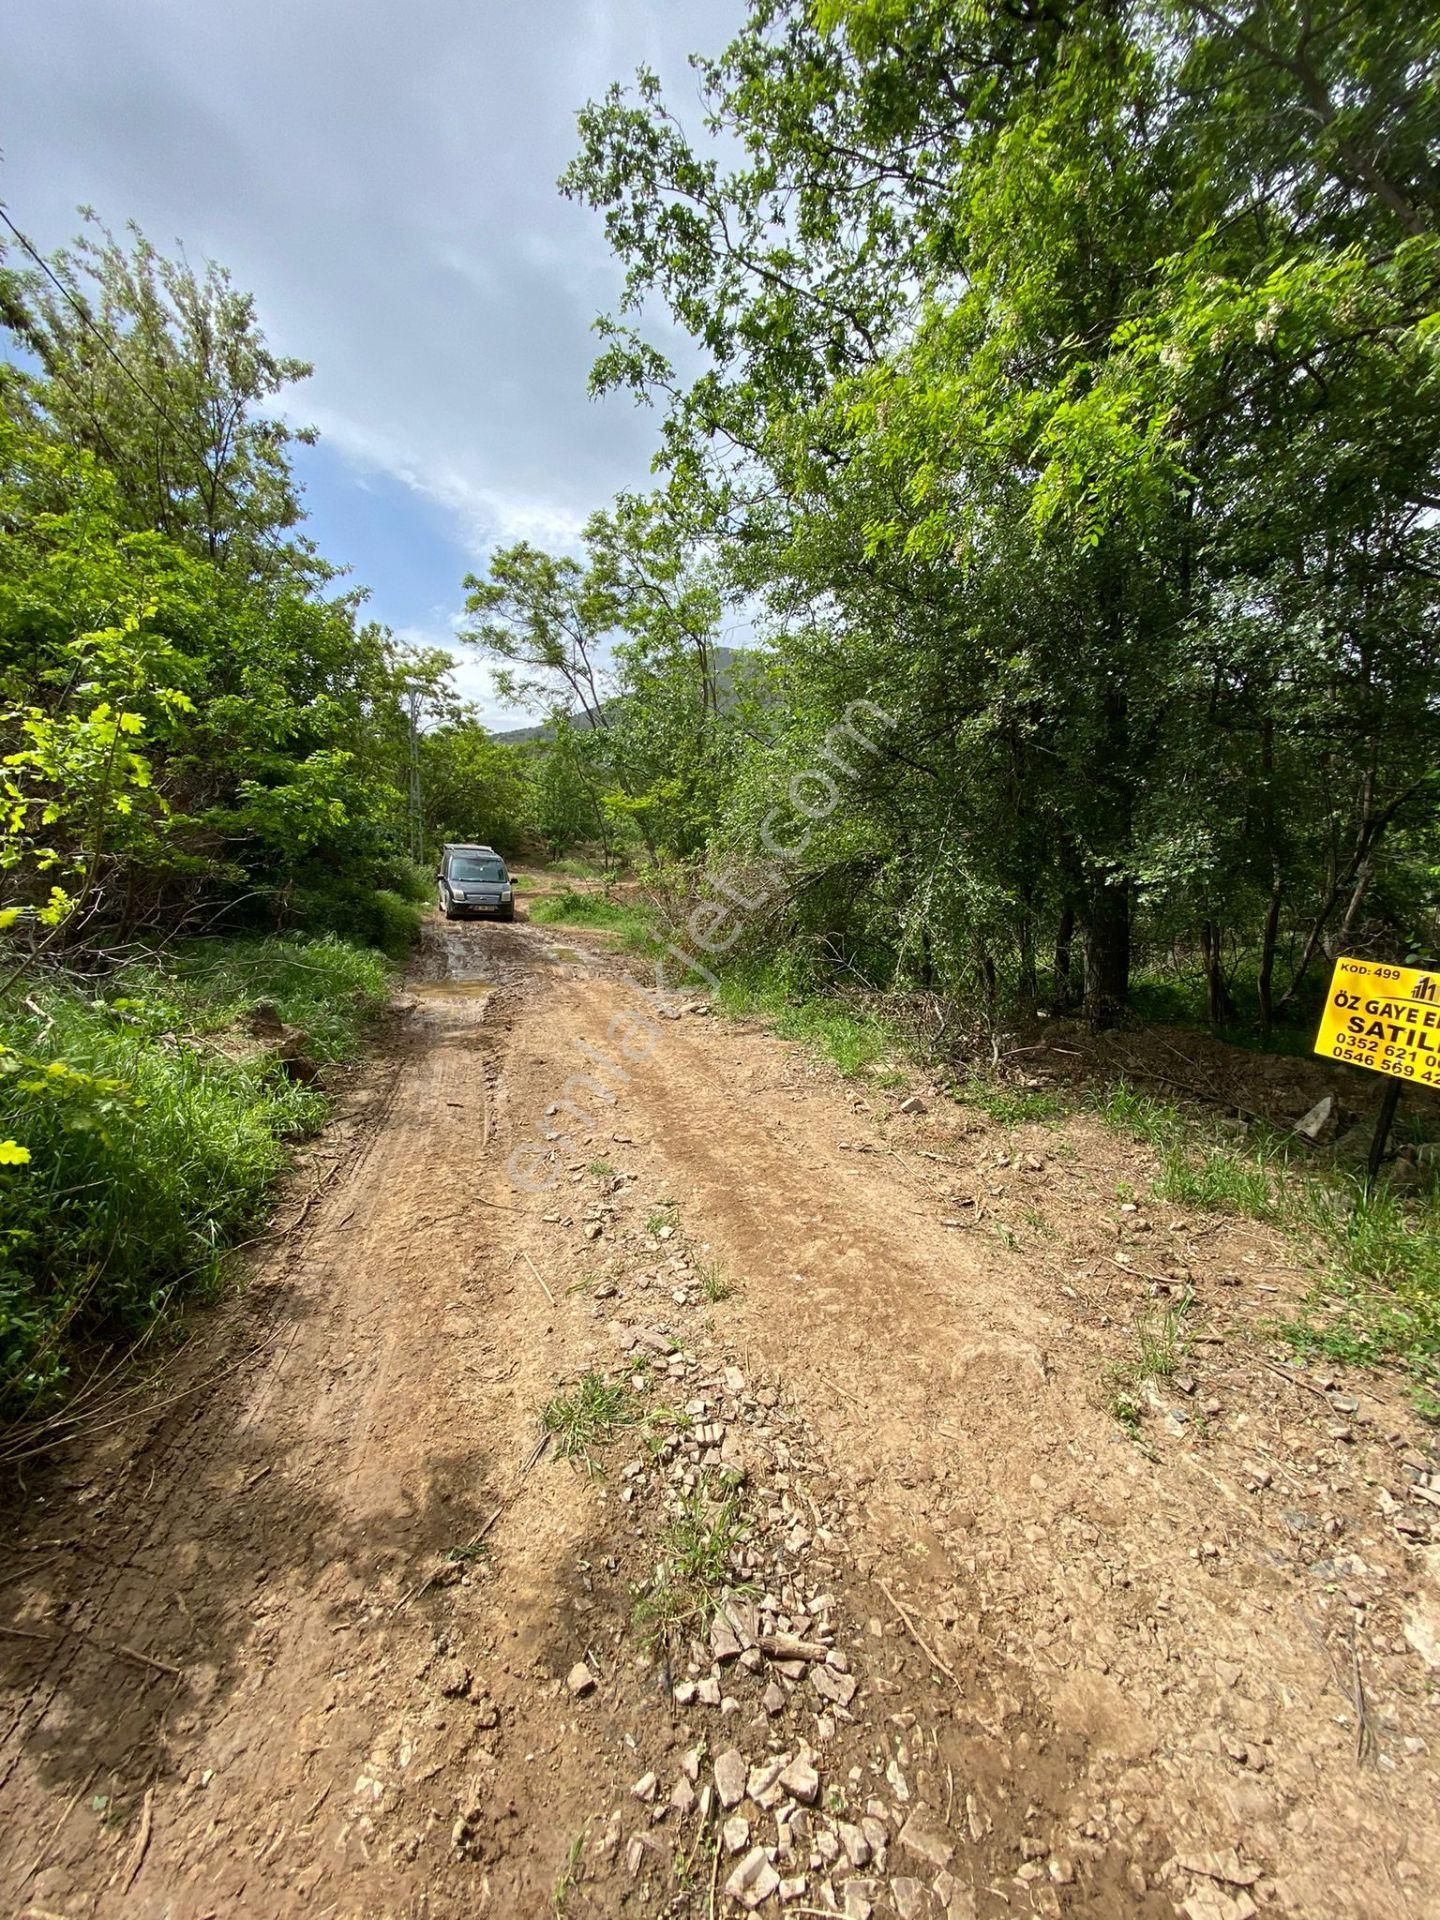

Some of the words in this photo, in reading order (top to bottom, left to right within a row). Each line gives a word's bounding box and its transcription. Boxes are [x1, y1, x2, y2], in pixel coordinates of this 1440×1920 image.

[1340, 963, 1371, 976] KOD:
[1373, 967, 1401, 981] 499
[1334, 989, 1361, 1011] ÖZ
[1365, 1000, 1419, 1024] GAYE
[1423, 1011, 1440, 1029] E
[1336, 1032, 1379, 1052] 0352
[1384, 1045, 1417, 1062] 621
[1425, 1055, 1440, 1069] 0
[1347, 1016, 1440, 1053] SATIL
[1332, 1046, 1375, 1066] 0546
[1380, 1059, 1415, 1077] 569
